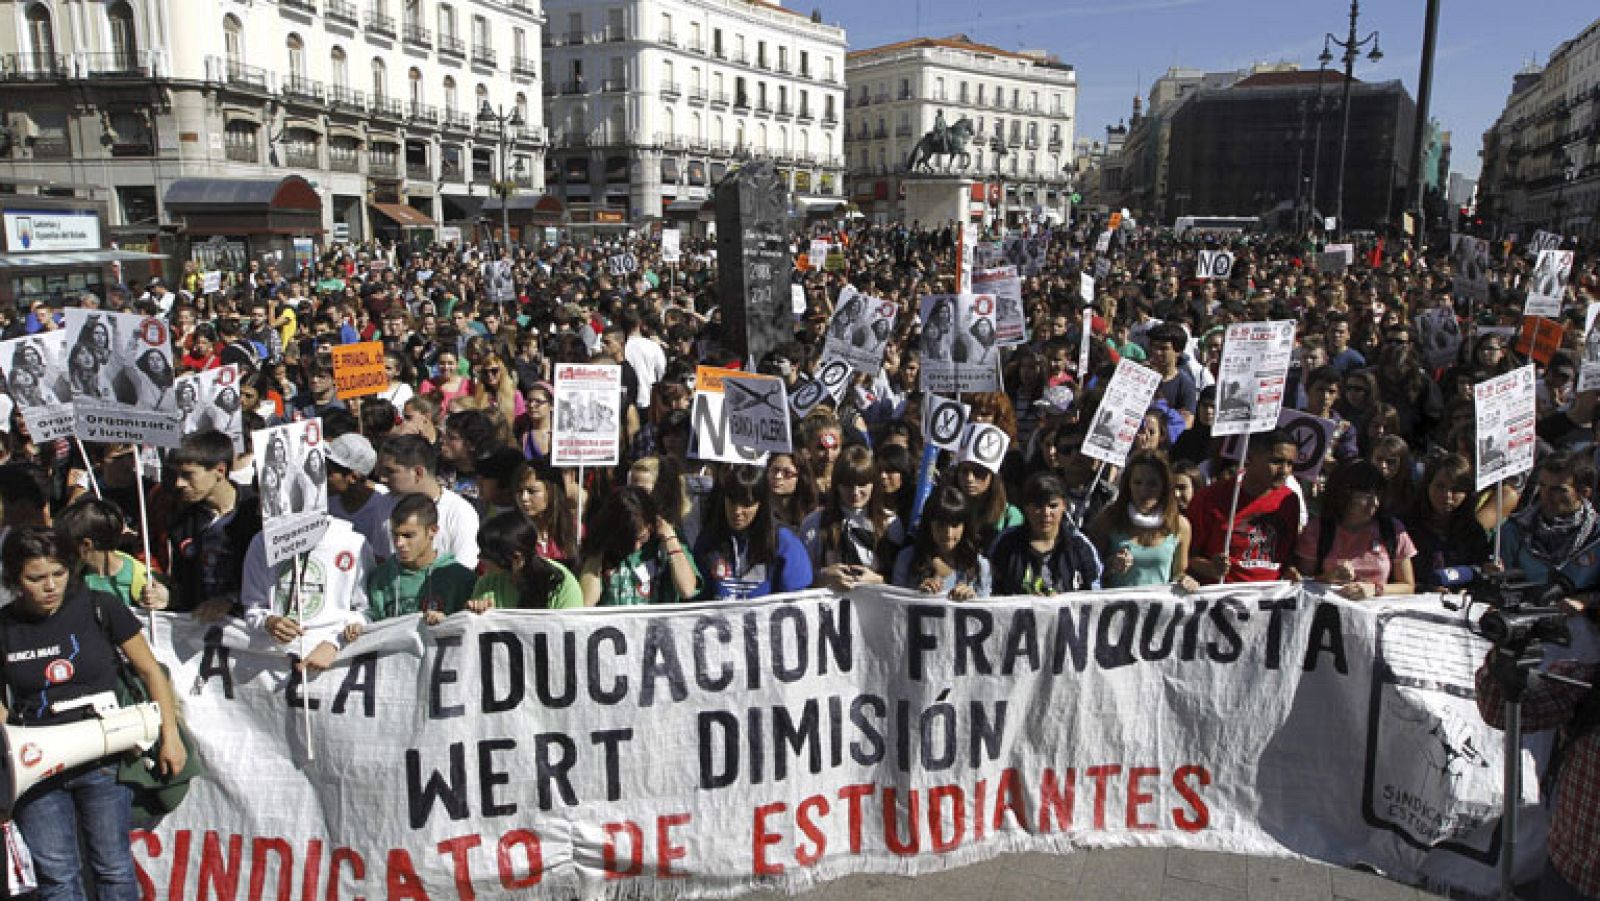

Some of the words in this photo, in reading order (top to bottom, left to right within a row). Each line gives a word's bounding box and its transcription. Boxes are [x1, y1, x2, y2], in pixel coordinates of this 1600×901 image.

[1199, 252, 1230, 276] NO
[190, 626, 235, 700] A
[283, 652, 378, 718] LA
[427, 599, 853, 720] EDUCACION
[907, 598, 1349, 681] FRANQUISTA
[404, 727, 634, 829] WERT
[698, 688, 1008, 790] DIMISIÓN
[129, 827, 545, 901] SINDICATO
[602, 813, 692, 880] DE
[753, 764, 1212, 875] ESTUDIANTES
